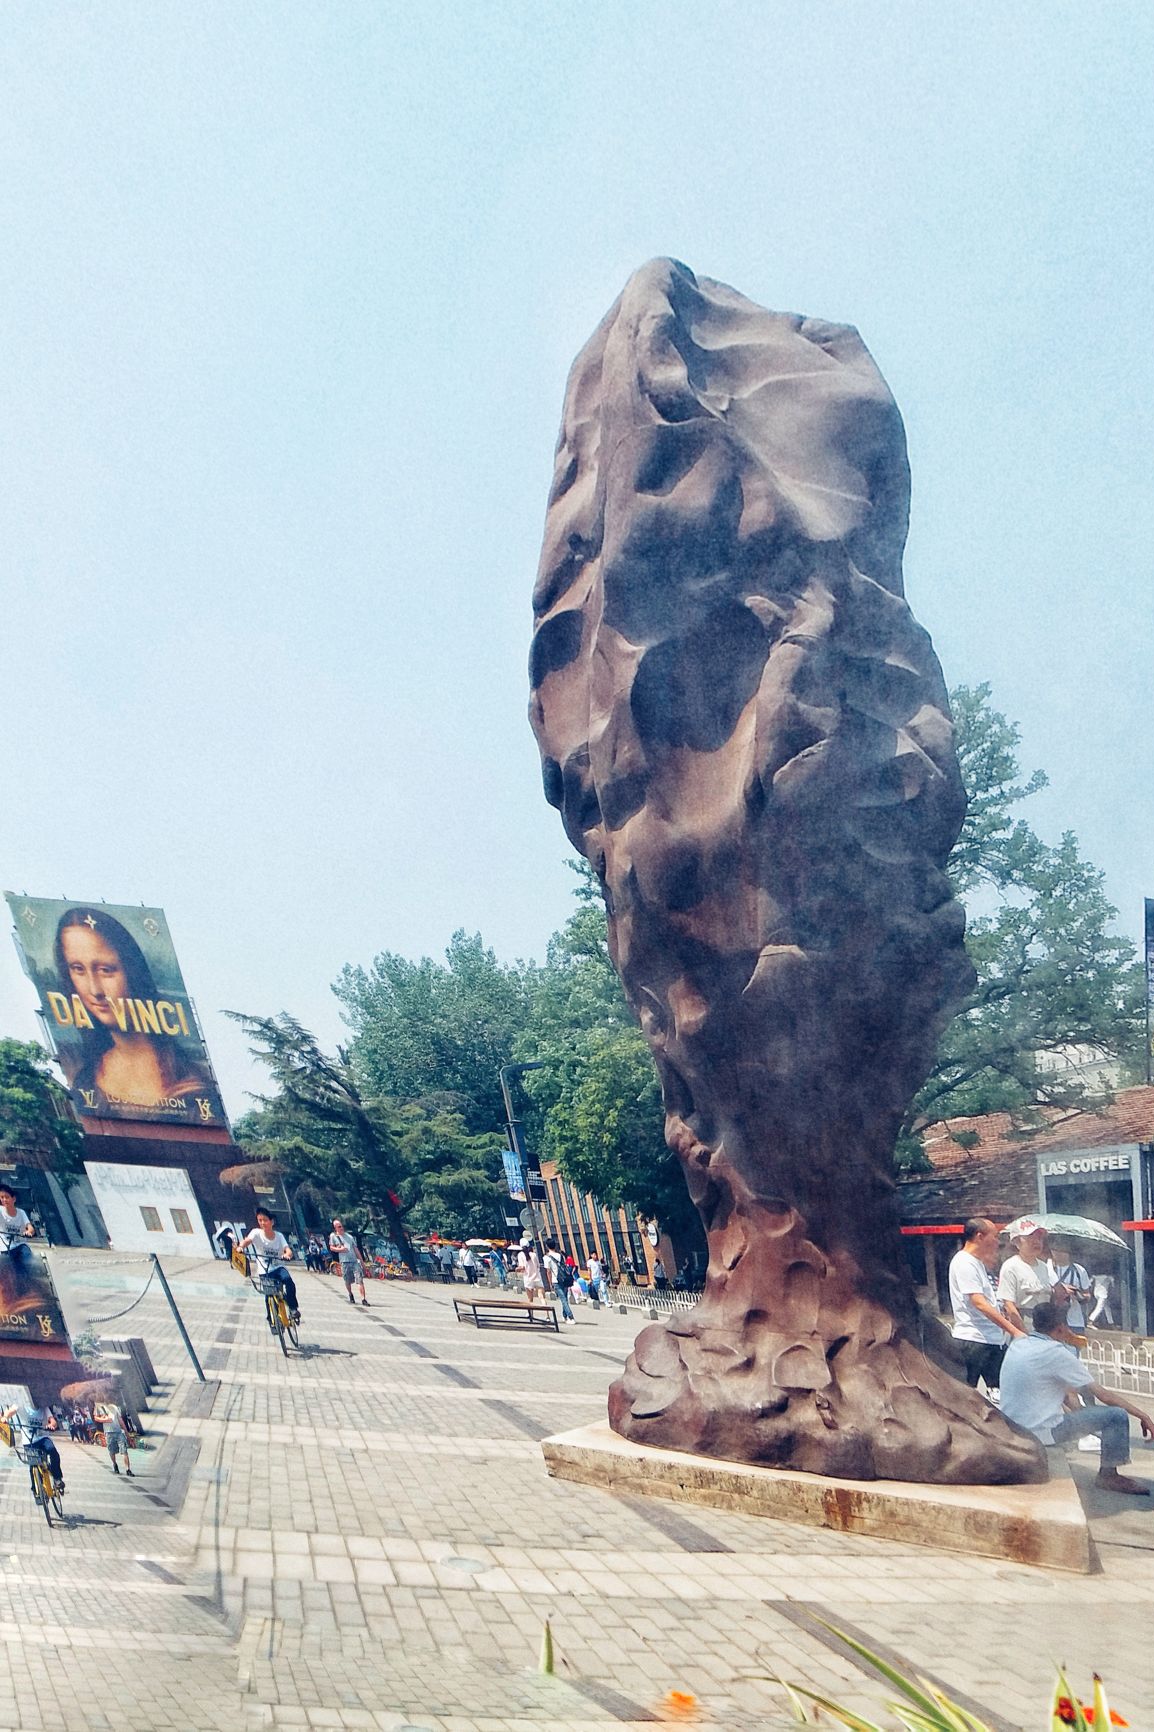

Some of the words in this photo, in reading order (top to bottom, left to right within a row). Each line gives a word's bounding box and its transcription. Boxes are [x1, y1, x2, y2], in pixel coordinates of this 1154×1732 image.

[47, 991, 94, 1029] DA
[105, 997, 190, 1036] VINCI
[1041, 1161, 1067, 1176] LAS
[1070, 1154, 1130, 1173] COFFEE
